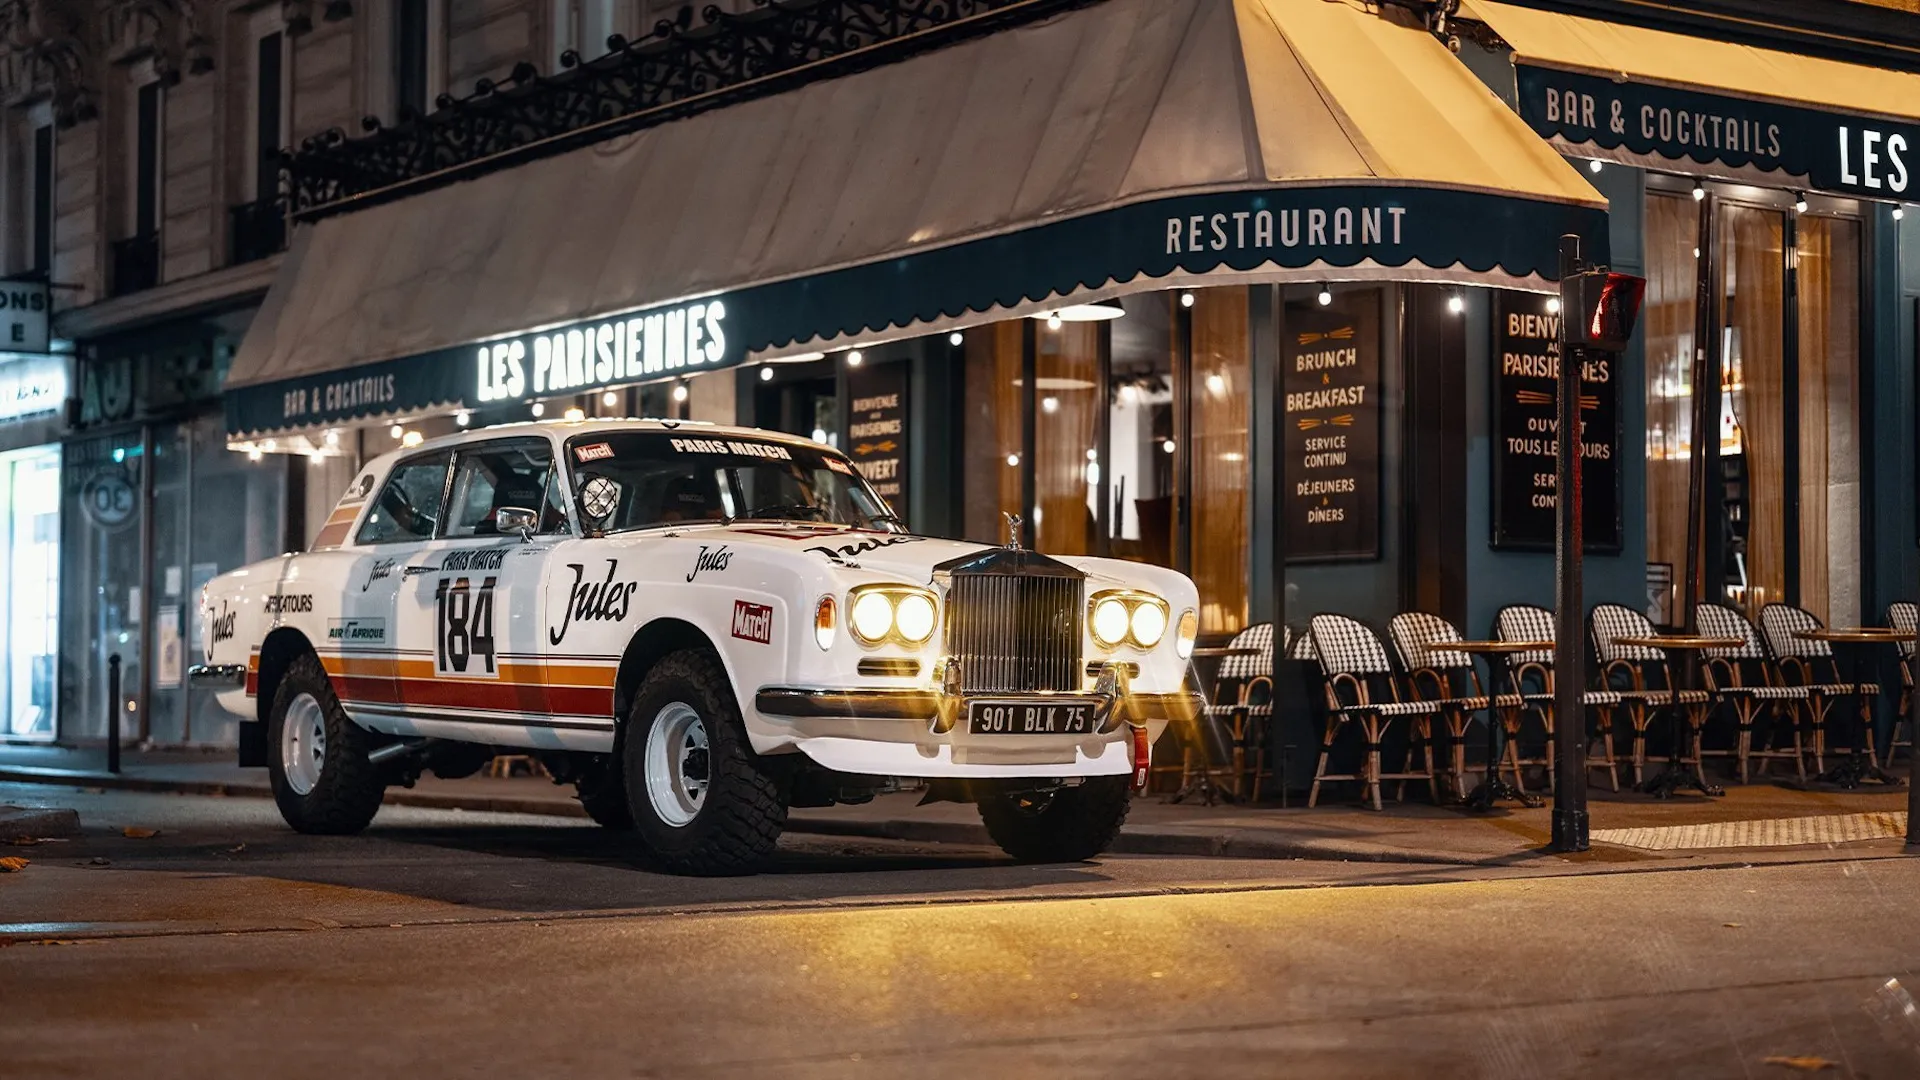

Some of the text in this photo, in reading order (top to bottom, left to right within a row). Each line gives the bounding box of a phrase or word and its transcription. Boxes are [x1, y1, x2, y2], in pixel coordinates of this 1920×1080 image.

[1546, 87, 1780, 158] BAR & COCKTAILS
[1838, 126, 1909, 193] LES
[1166, 206, 1406, 254] RESTAURANT
[1508, 313, 1559, 339] BIENV
[477, 300, 726, 402] LES PARISIENNES
[1296, 348, 1357, 372] BRUNCH
[1321, 373, 1331, 385] &
[1503, 352, 1609, 383] PARISIENES
[284, 373, 395, 418] BAR & COCKTAILS
[1286, 385, 1366, 413] BREAKFAST
[1528, 417, 1587, 435] OUVT
[577, 444, 613, 461] MATCH
[670, 439, 793, 460] PARIS MATCH
[1305, 435, 1347, 451] SERVICE
[1507, 437, 1611, 459] TOUS LE OURS
[1304, 452, 1347, 468] CONTINU
[1297, 478, 1355, 496] DÉJEUNERS
[1308, 506, 1344, 524] DÎNERS
[441, 549, 511, 571] PARIS MATCH
[686, 545, 733, 583] Jules
[362, 557, 396, 592] Jules
[550, 559, 637, 646] Jules
[207, 599, 236, 662] Jules
[328, 628, 384, 639] AIR AFRIQUE
[435, 576, 497, 674] 184
[733, 604, 771, 641] MATCH
[981, 706, 1086, 732] 901 BLK 75
